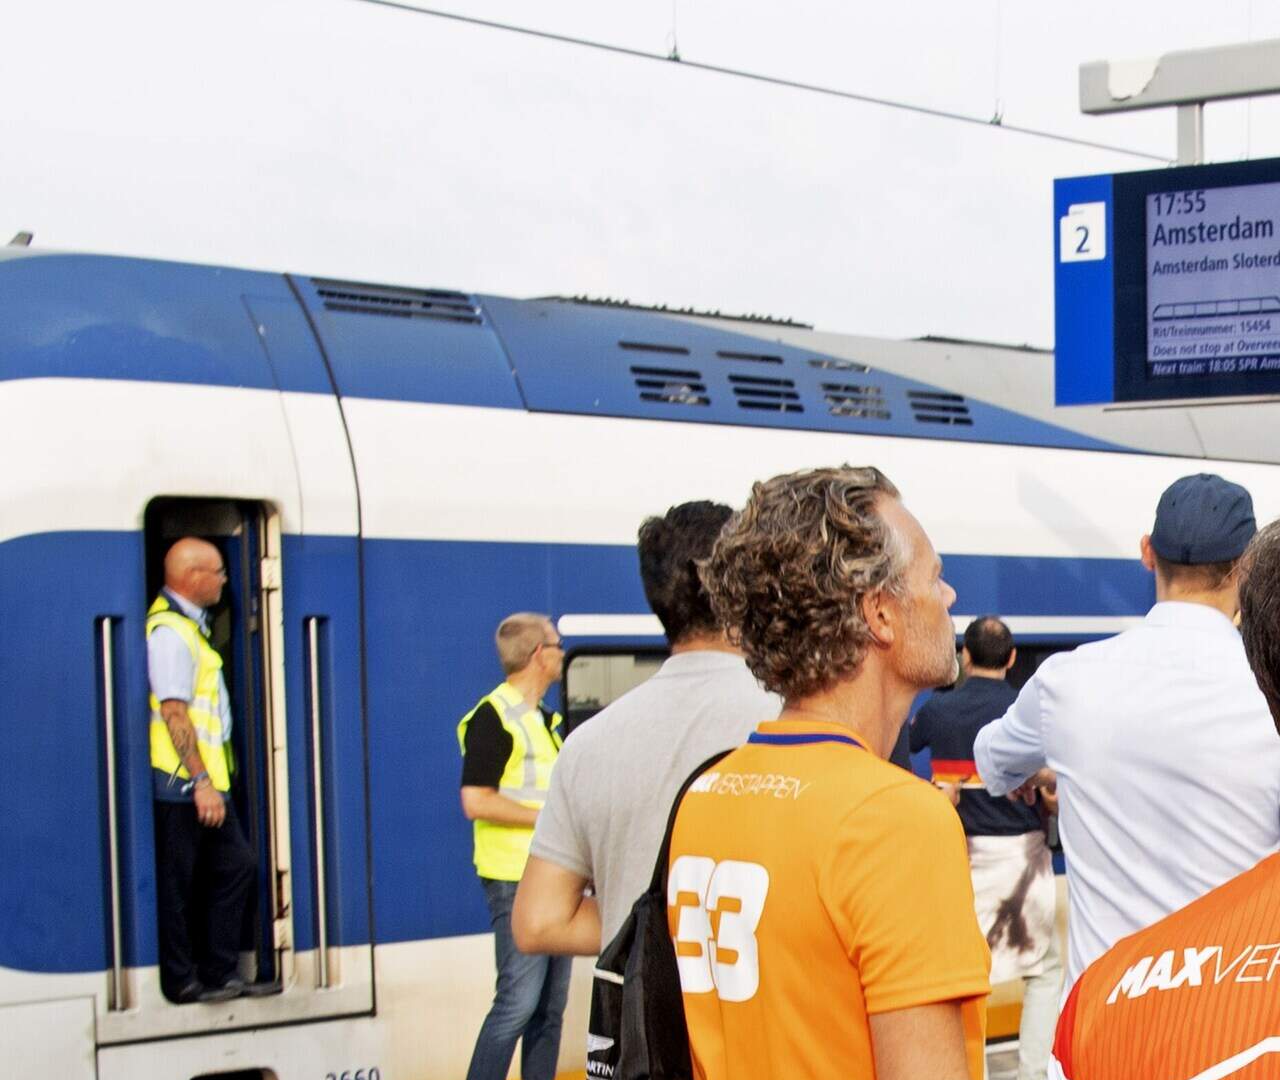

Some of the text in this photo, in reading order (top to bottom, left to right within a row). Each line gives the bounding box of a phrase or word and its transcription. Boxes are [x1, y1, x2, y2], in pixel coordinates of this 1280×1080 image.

[1153, 191, 1206, 216] 17:55
[1075, 225, 1091, 254] 2
[1152, 216, 1273, 247] Amsterdam
[1152, 254, 1228, 276] Amsterdam
[1153, 345, 1177, 356] Does
[1180, 344, 1196, 355] not
[1200, 342, 1221, 355] stop
[1224, 341, 1234, 351] at
[1153, 363, 1177, 375] Next
[1209, 359, 1236, 372] 18:05
[1239, 357, 1258, 370] SPR
[667, 855, 769, 1002] 33
[586, 1060, 615, 1077] ARTIN
